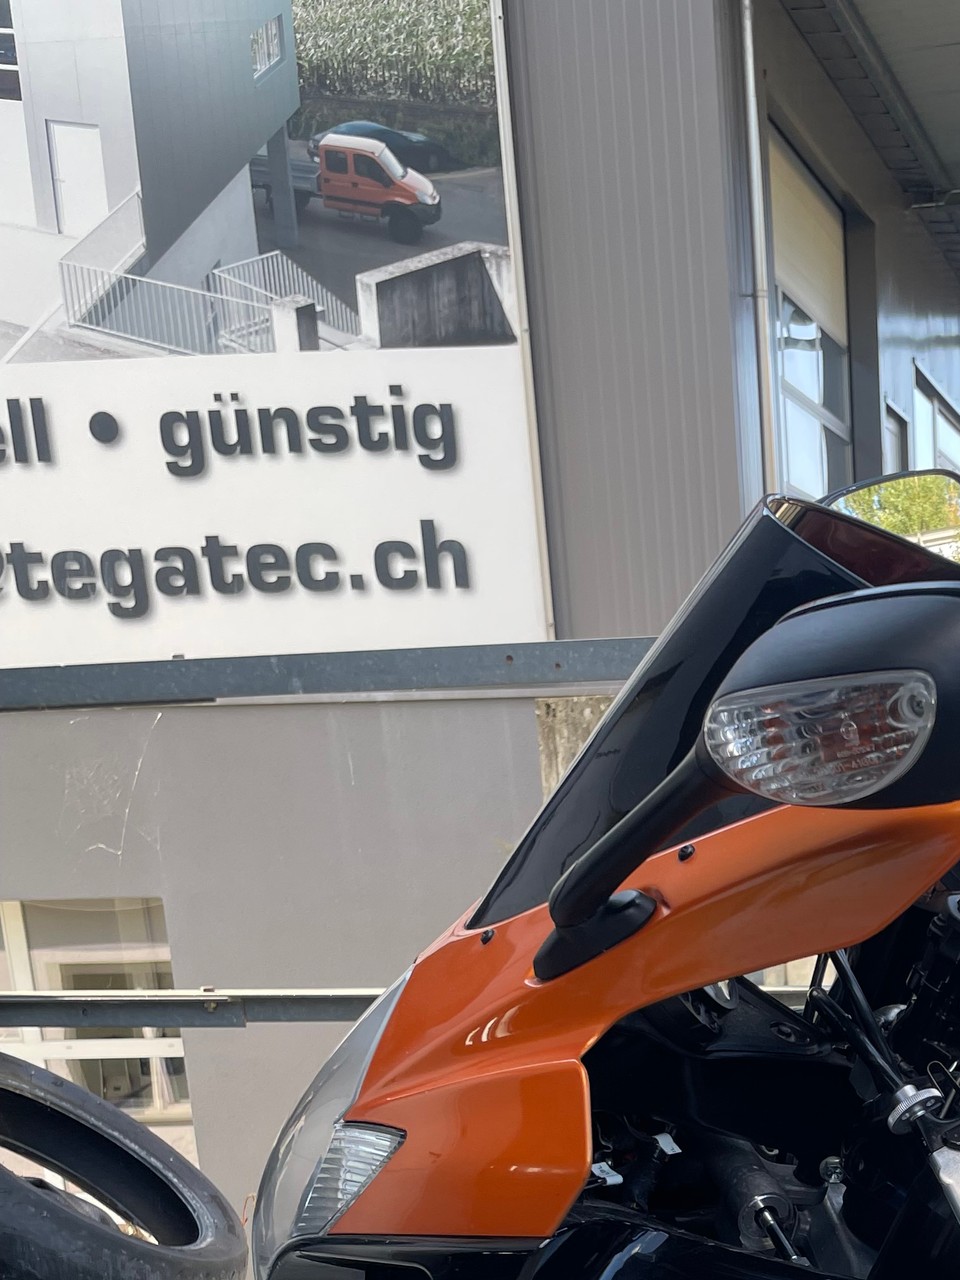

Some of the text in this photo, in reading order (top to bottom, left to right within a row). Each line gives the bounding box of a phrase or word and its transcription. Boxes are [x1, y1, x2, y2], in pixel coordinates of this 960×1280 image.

[0, 385, 457, 477] ll günstig
[0, 519, 471, 619] tegatec.ch
